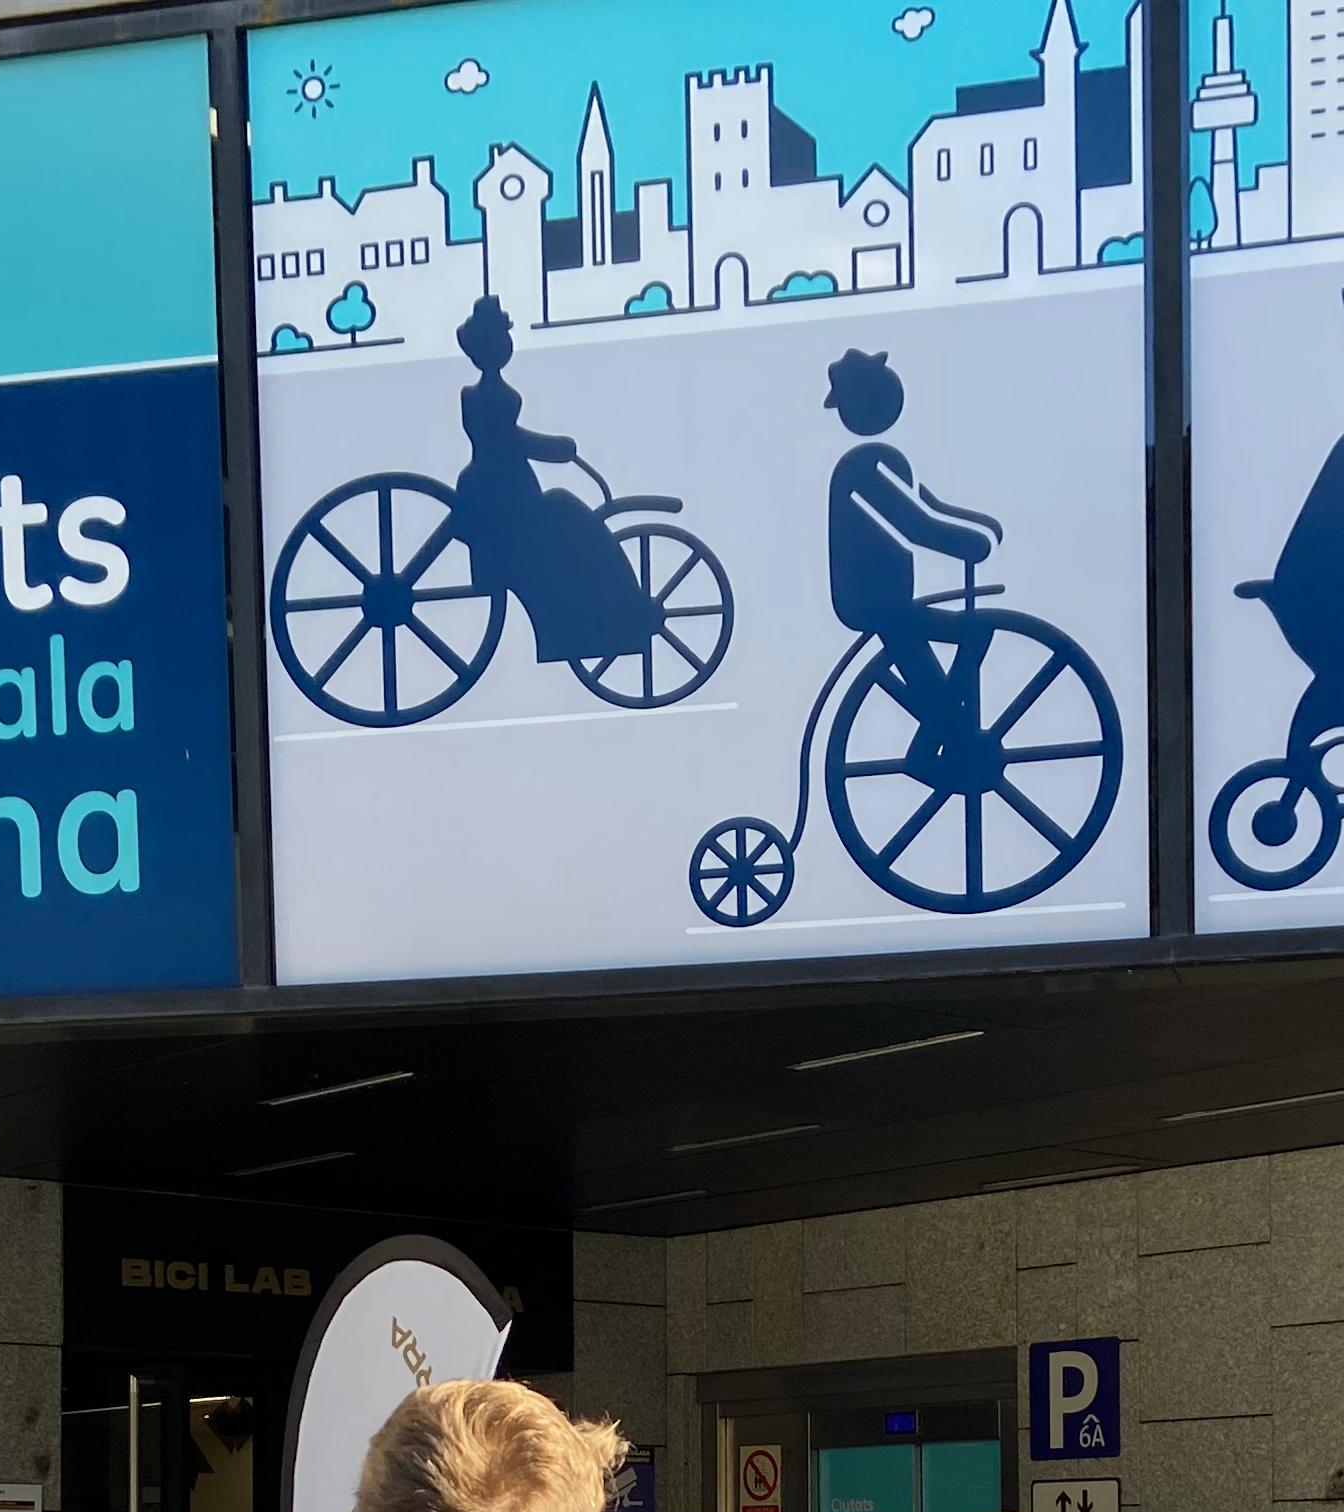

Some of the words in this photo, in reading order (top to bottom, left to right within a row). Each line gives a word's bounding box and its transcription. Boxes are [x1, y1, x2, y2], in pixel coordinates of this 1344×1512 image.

[121, 1257, 208, 1291] BICI
[224, 1264, 312, 1297] LAB
[1048, 1350, 1099, 1450] P
